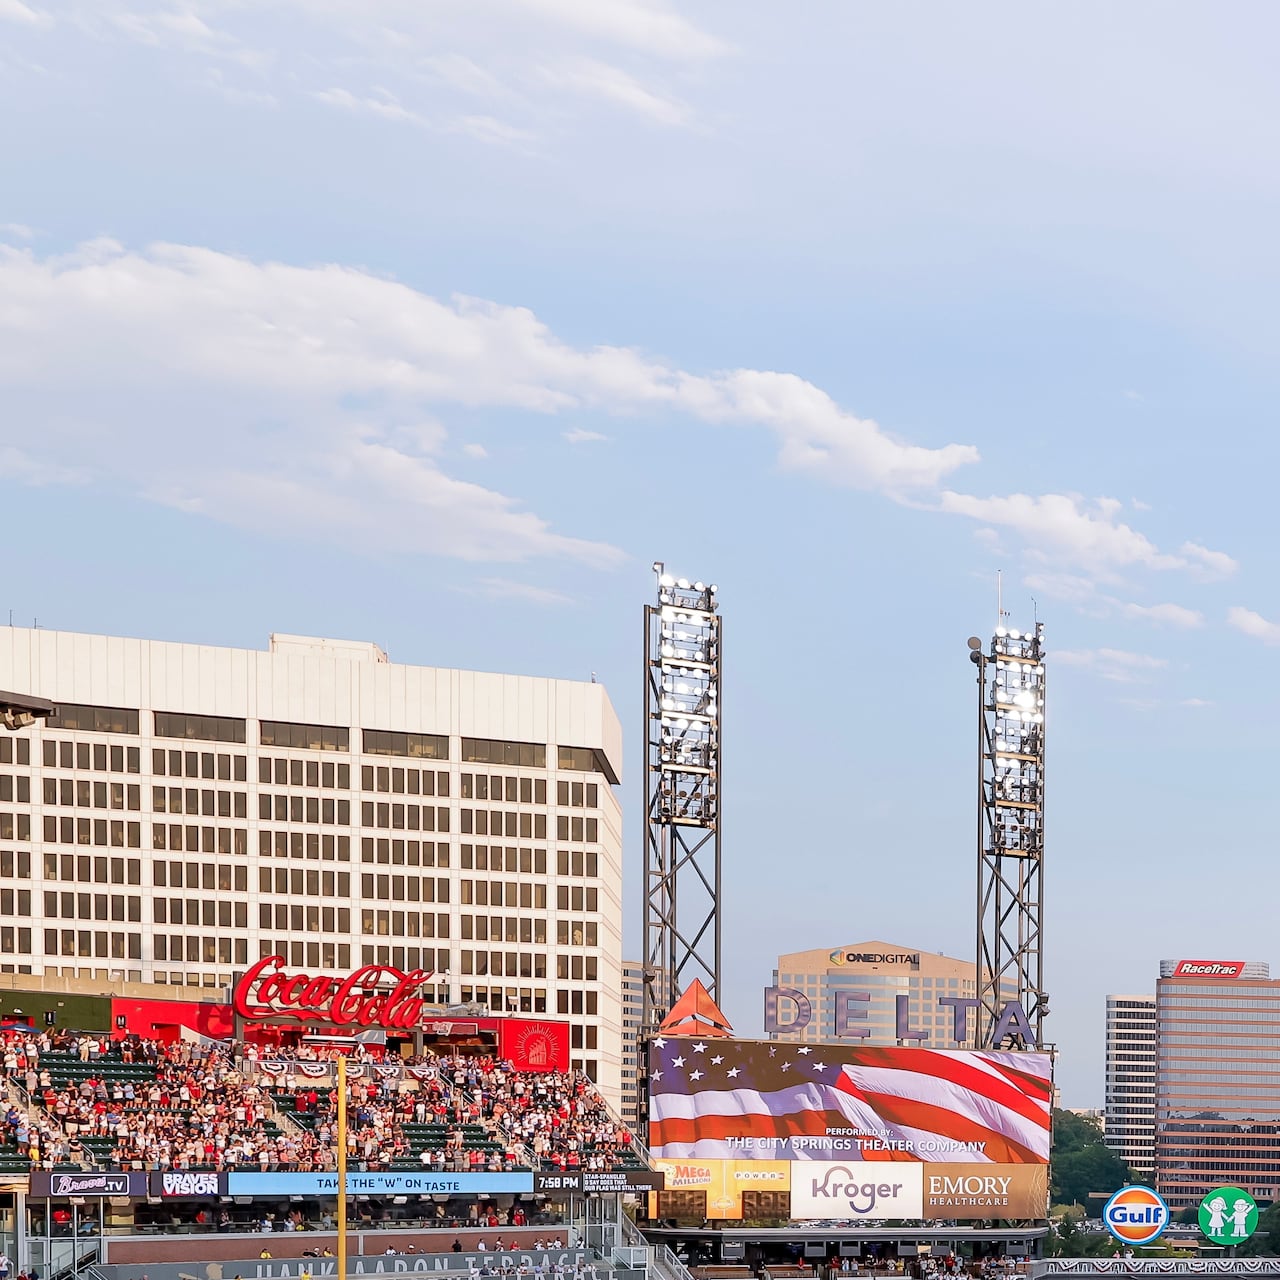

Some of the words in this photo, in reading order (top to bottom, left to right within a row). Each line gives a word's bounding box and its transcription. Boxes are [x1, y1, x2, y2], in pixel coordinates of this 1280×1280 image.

[846, 953, 920, 966] ONEDIGITAL
[1179, 962, 1238, 976] RaceTrac
[233, 956, 435, 1029] Coca-Cola
[764, 986, 1036, 1045] DELTA
[826, 1128, 876, 1138] PERFORMED
[726, 1136, 754, 1149] THE
[756, 1137, 788, 1150] CITY
[792, 1138, 852, 1151] SPRINGS
[855, 1139, 914, 1152] THEATER
[918, 1140, 986, 1153] COMPANY
[676, 1166, 710, 1178] MEGA
[162, 1174, 218, 1184] BRAVES
[352, 1178, 375, 1188] THE
[406, 1178, 422, 1188] ON
[424, 1181, 460, 1191] TASTE
[539, 1177, 562, 1188] 7:58
[564, 1178, 579, 1188] PM
[162, 1184, 218, 1194] VISION
[812, 1166, 903, 1214] Kroger
[928, 1176, 1012, 1196] EMORY
[928, 1197, 1009, 1206] HEALTHCARE
[1108, 1206, 1164, 1227] Gulf
